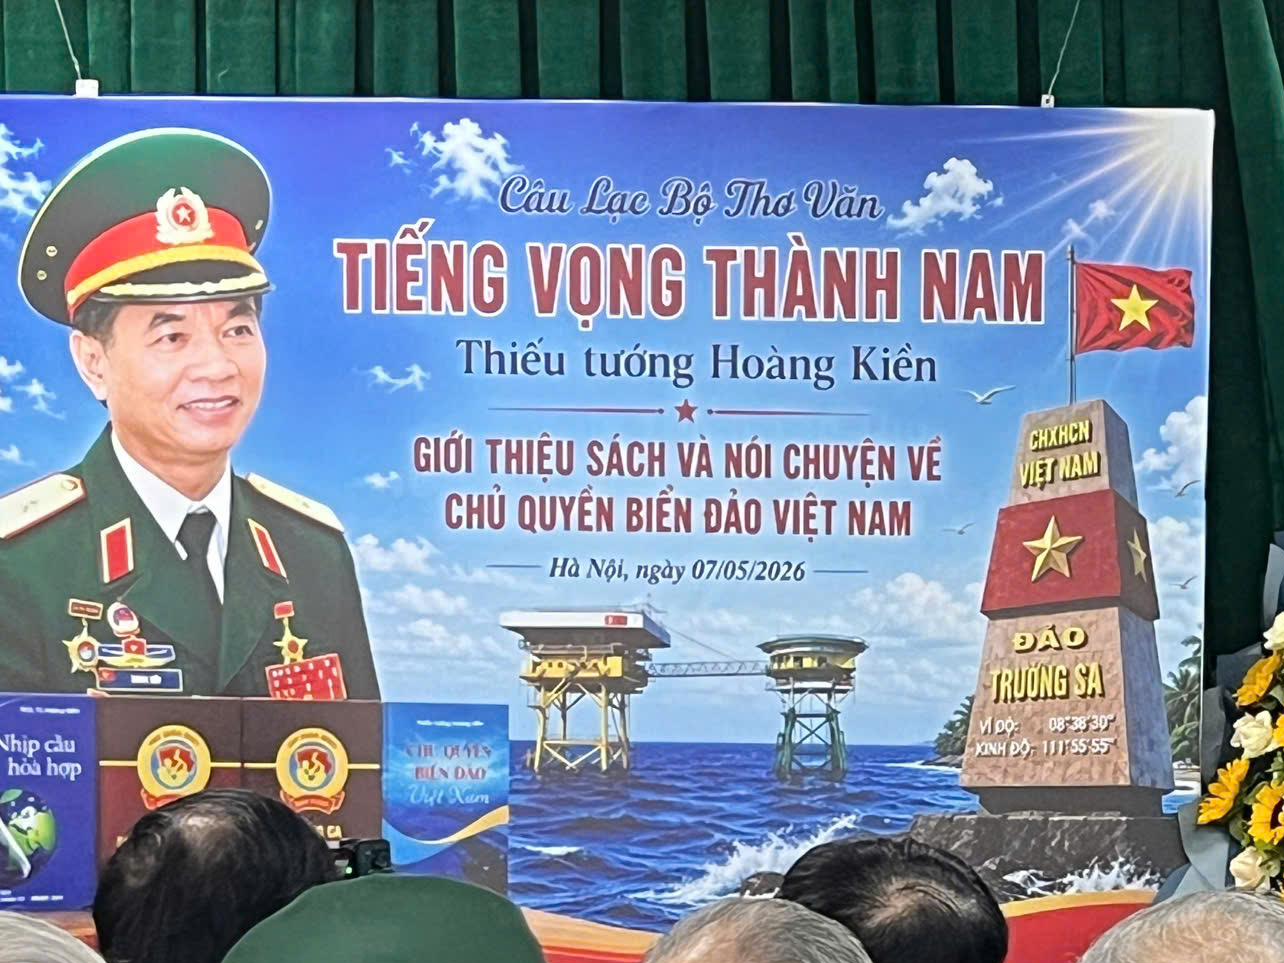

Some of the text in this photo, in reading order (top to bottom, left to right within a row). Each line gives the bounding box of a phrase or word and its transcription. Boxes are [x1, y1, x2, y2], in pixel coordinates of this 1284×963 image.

[500, 174, 885, 226] Câu Lạc Bộ Thơ Văn
[333, 218, 1045, 331] TIẾNG VỌNG THÀNH NAM
[455, 336, 937, 391] Thiếu tướng Hoàng Kiền
[414, 429, 942, 488] GIỚI THIỆU SÁCH VÀ NÓI CHUYỆN VỀ
[1030, 420, 1092, 452] CHXHCN
[1060, 450, 1101, 481] NAM
[445, 483, 912, 543] CHỦ QUYỀN BIỂN ĐẢO VIỆT NAM
[549, 556, 806, 585] Hà Nội, ngày 07/05/2026
[1073, 662, 1105, 699] SA
